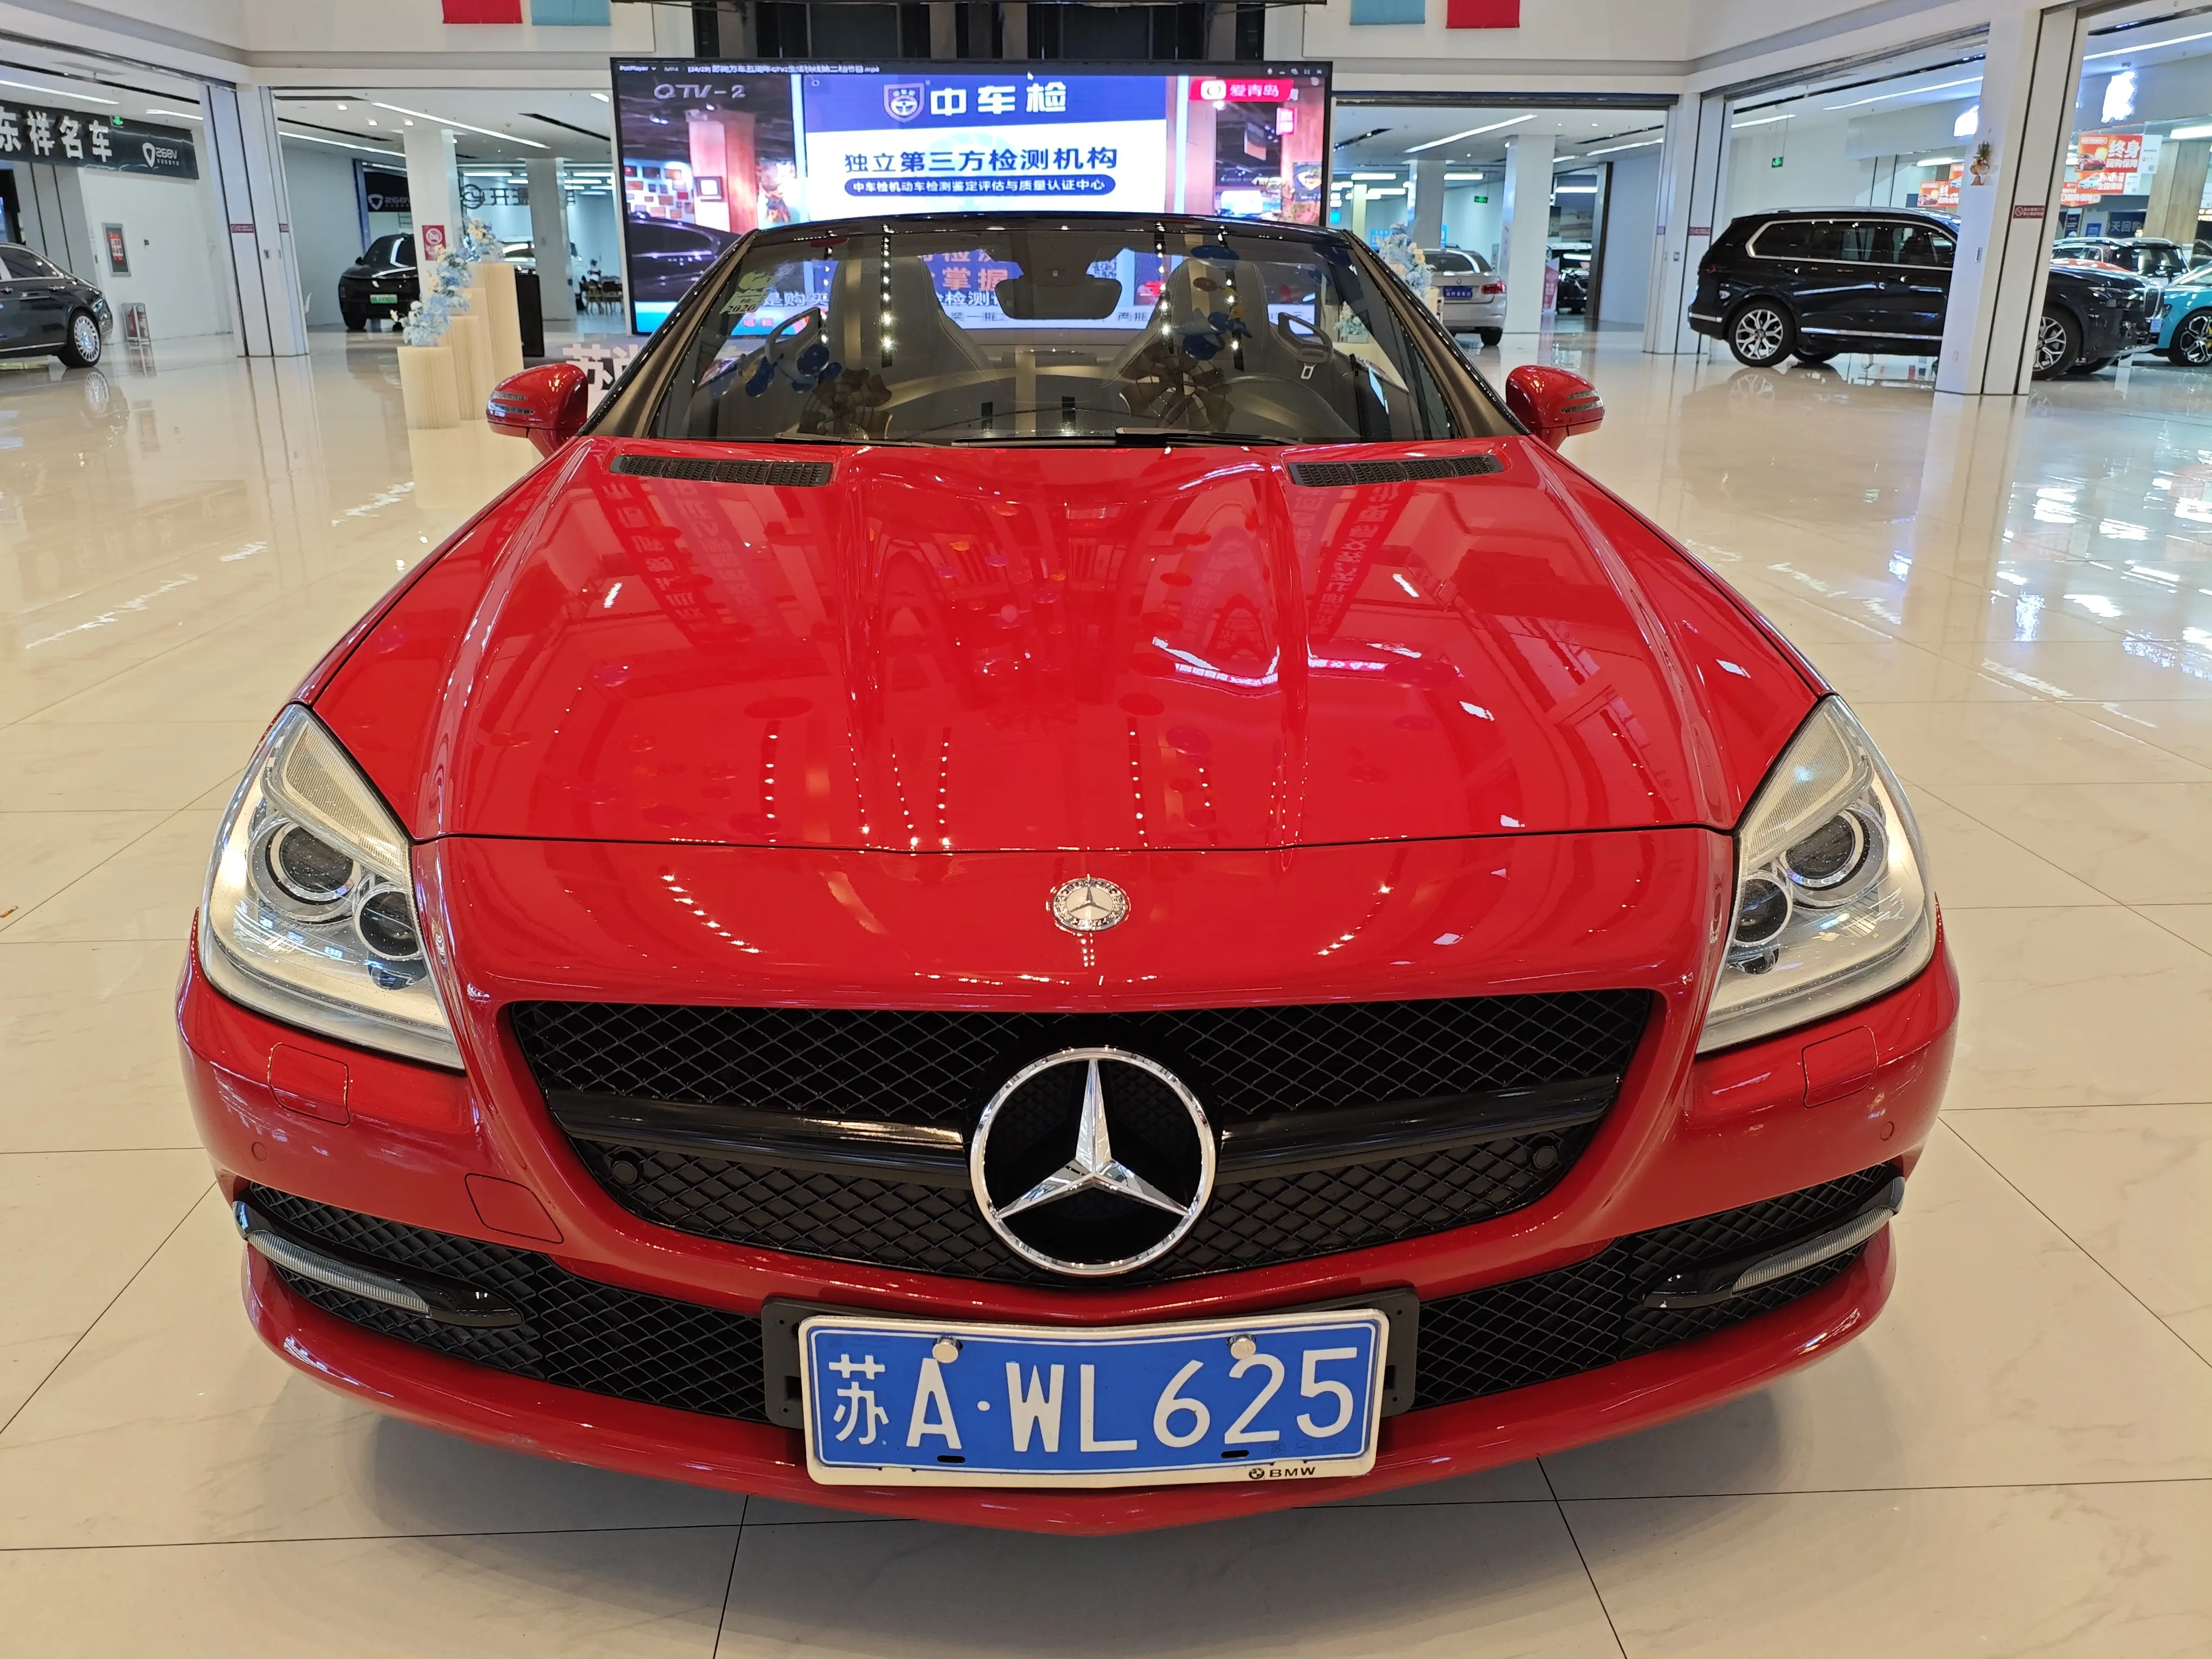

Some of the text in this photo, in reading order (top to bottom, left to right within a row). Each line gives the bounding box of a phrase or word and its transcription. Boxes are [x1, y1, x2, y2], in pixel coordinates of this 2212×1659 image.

[930, 82, 1067, 117] 中车检
[1230, 84, 1279, 97] 爱青岛
[0, 106, 112, 163] 东祥名车
[2108, 139, 2141, 158] 终身
[844, 146, 1118, 173] 独立第三方检测机构
[852, 179, 1105, 193] 中车检机动车检测鉴定评估与质量认证中心
[724, 304, 756, 313] 2020
[828, 1347, 1358, 1452] 苏A·WL625
[1269, 1466, 1316, 1478] BMW
